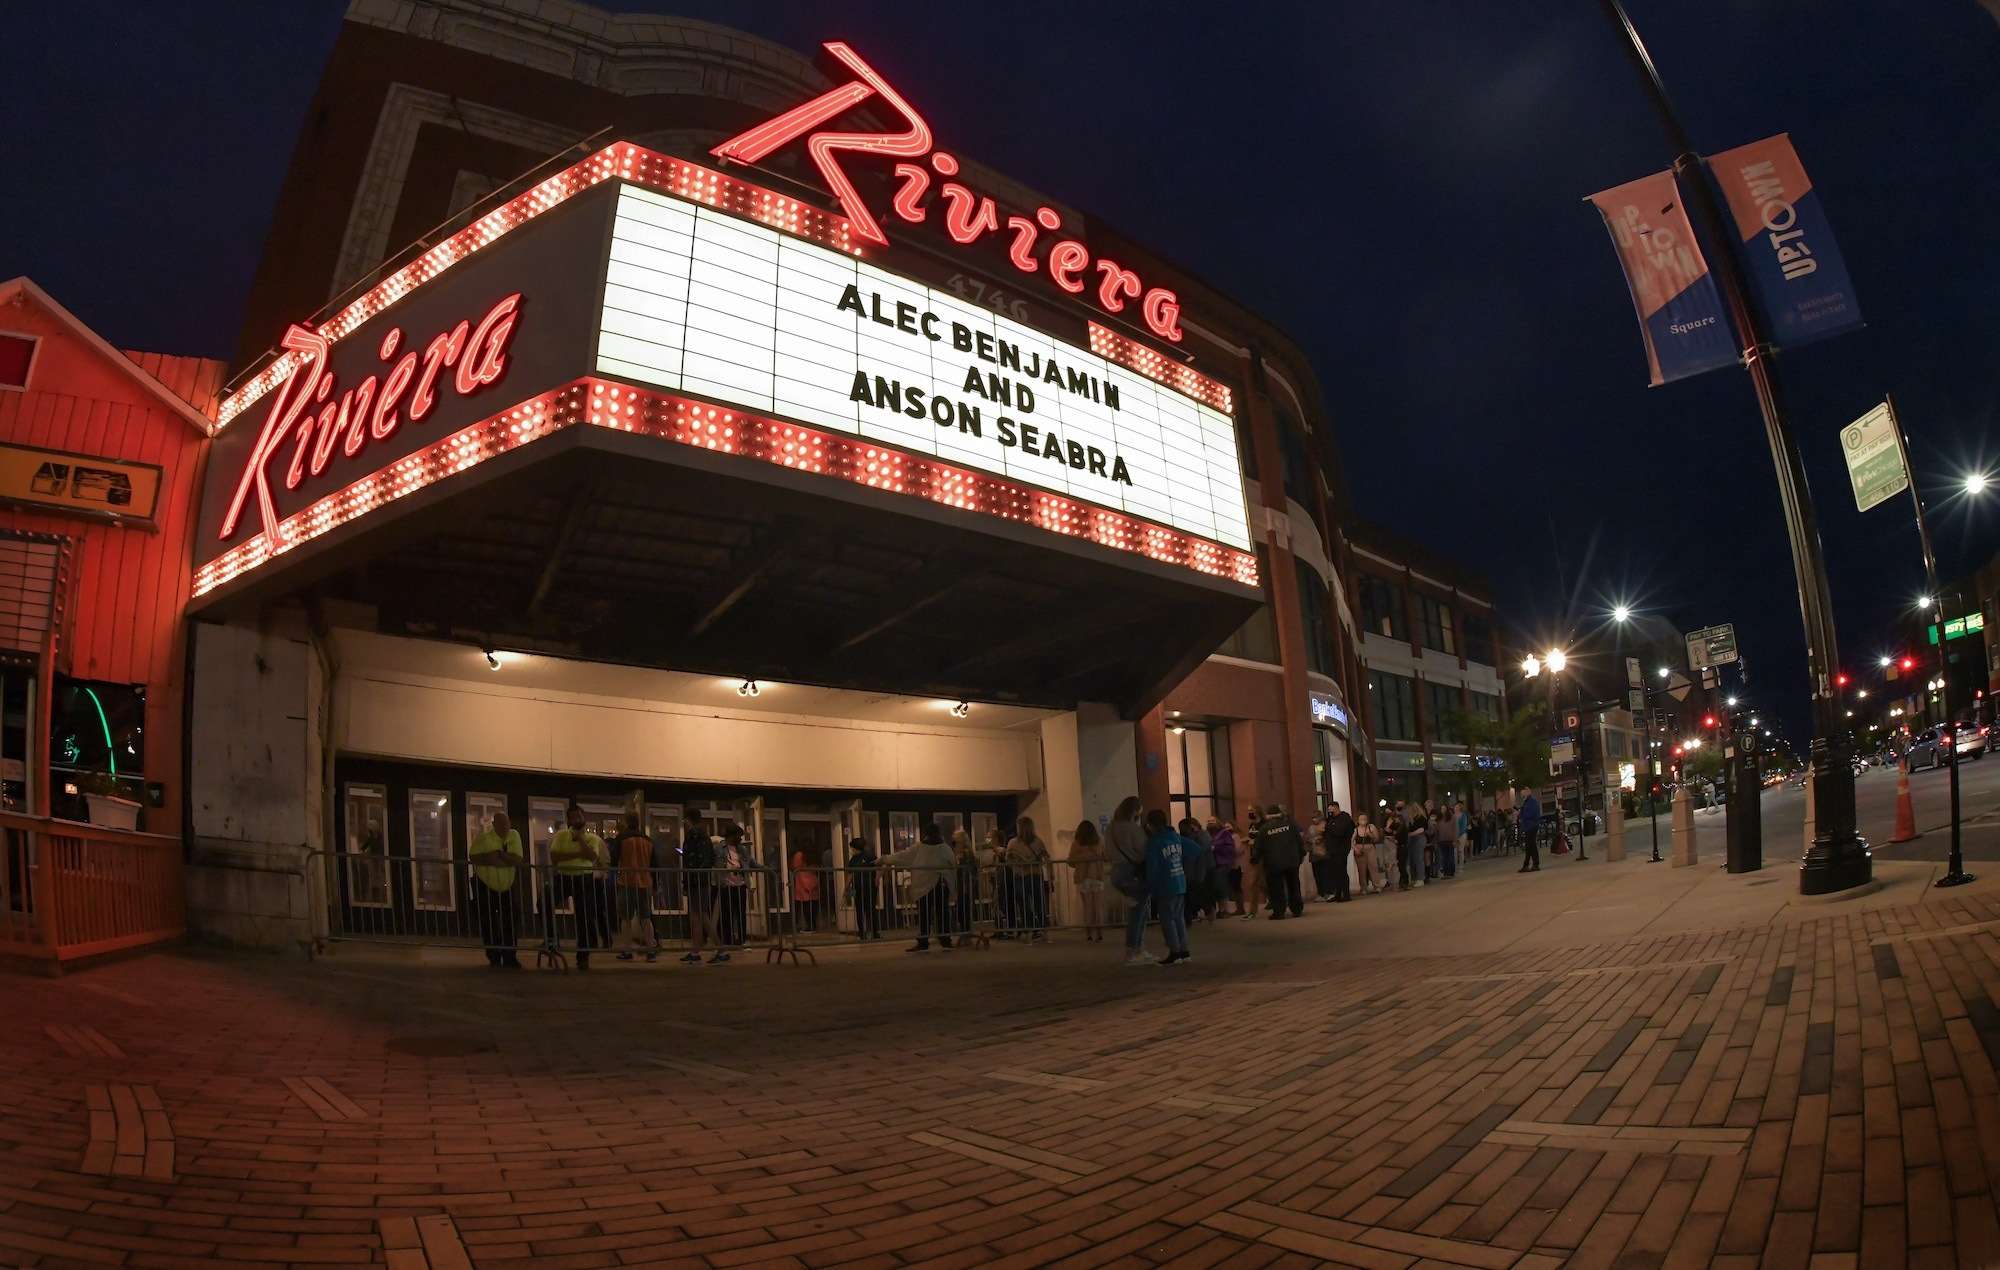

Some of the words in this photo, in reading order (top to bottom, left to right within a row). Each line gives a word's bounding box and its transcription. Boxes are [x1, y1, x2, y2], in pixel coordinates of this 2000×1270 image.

[709, 41, 1183, 343] Riviera
[946, 273, 1029, 323] 4746
[1669, 316, 1716, 335] Square
[837, 283, 942, 342] ALEC
[952, 320, 1121, 412] BENJAMIN
[218, 291, 522, 556] Riviera
[849, 370, 983, 438] ANSON
[996, 416, 1134, 487] SEABRA
[962, 365, 1036, 414] AND
[1267, 825, 1290, 836] SAFETY
